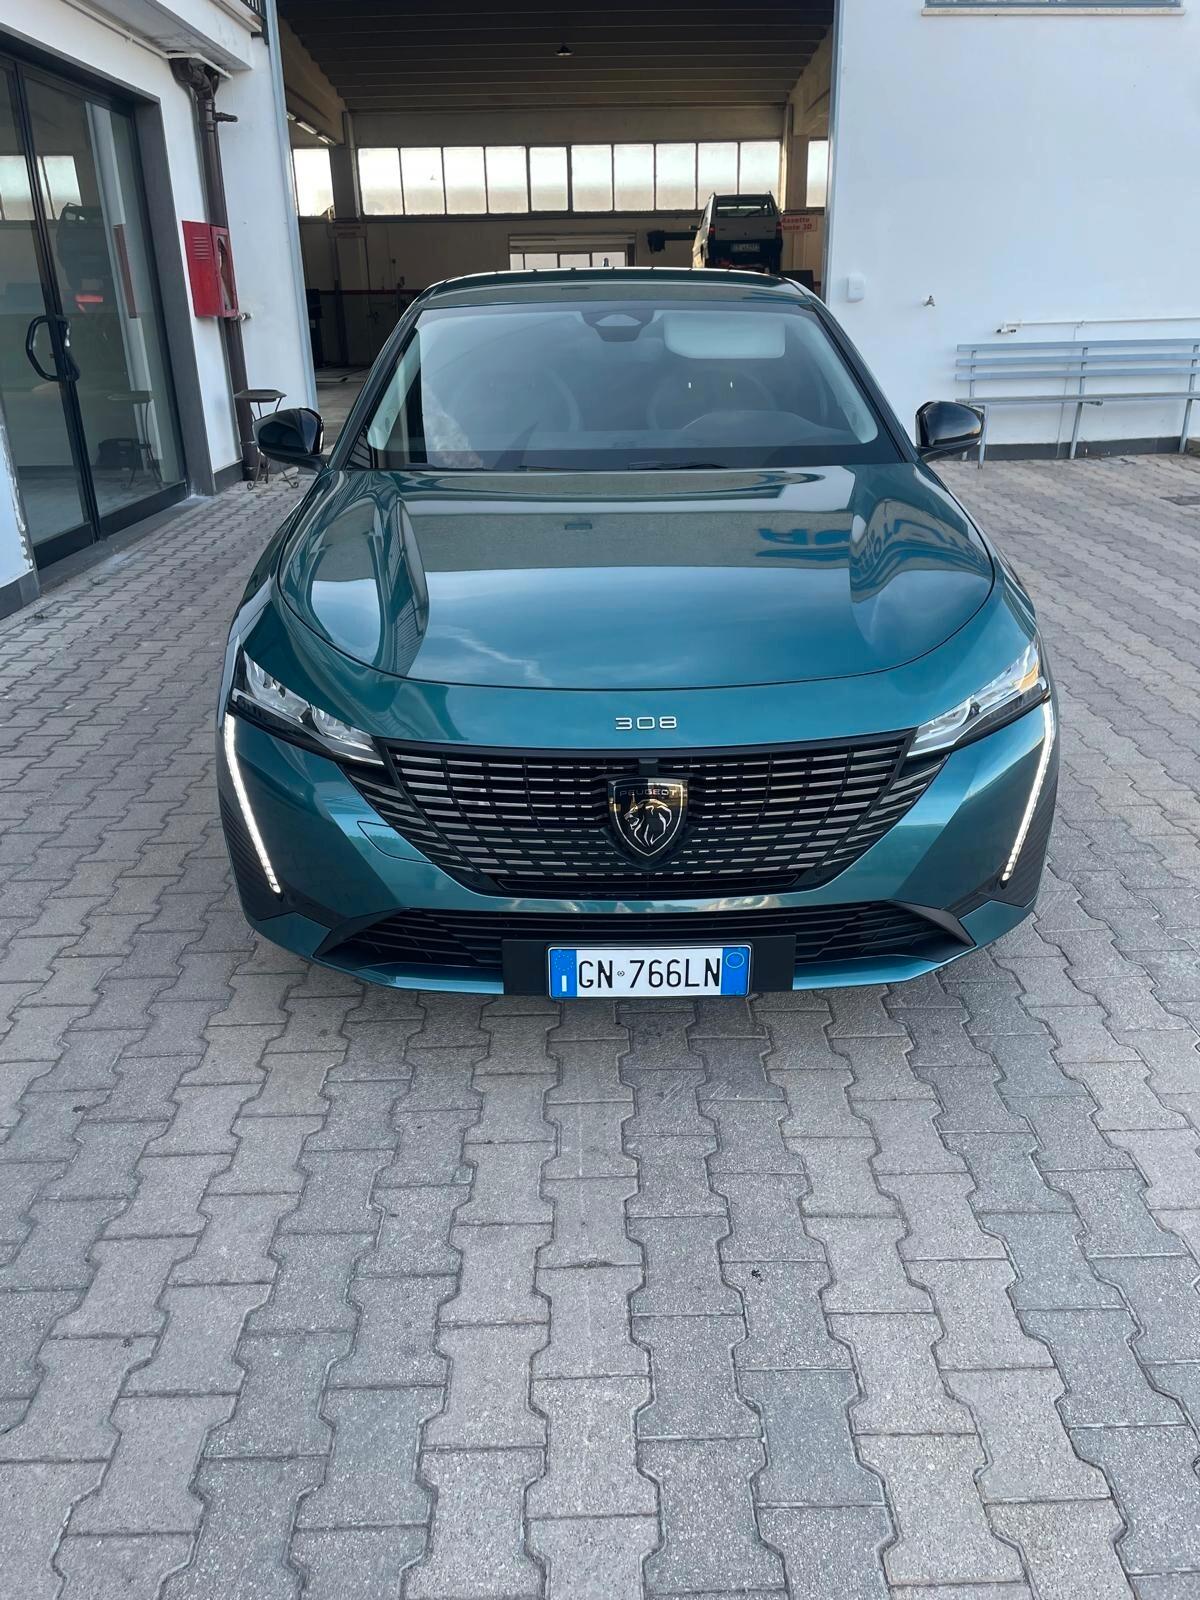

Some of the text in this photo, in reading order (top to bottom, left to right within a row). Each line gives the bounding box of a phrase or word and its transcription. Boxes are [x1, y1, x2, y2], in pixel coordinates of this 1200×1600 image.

[615, 716, 677, 730] 308
[619, 789, 677, 797] PEUGEOT
[578, 960, 613, 988] GN
[629, 957, 720, 988] 766LN
